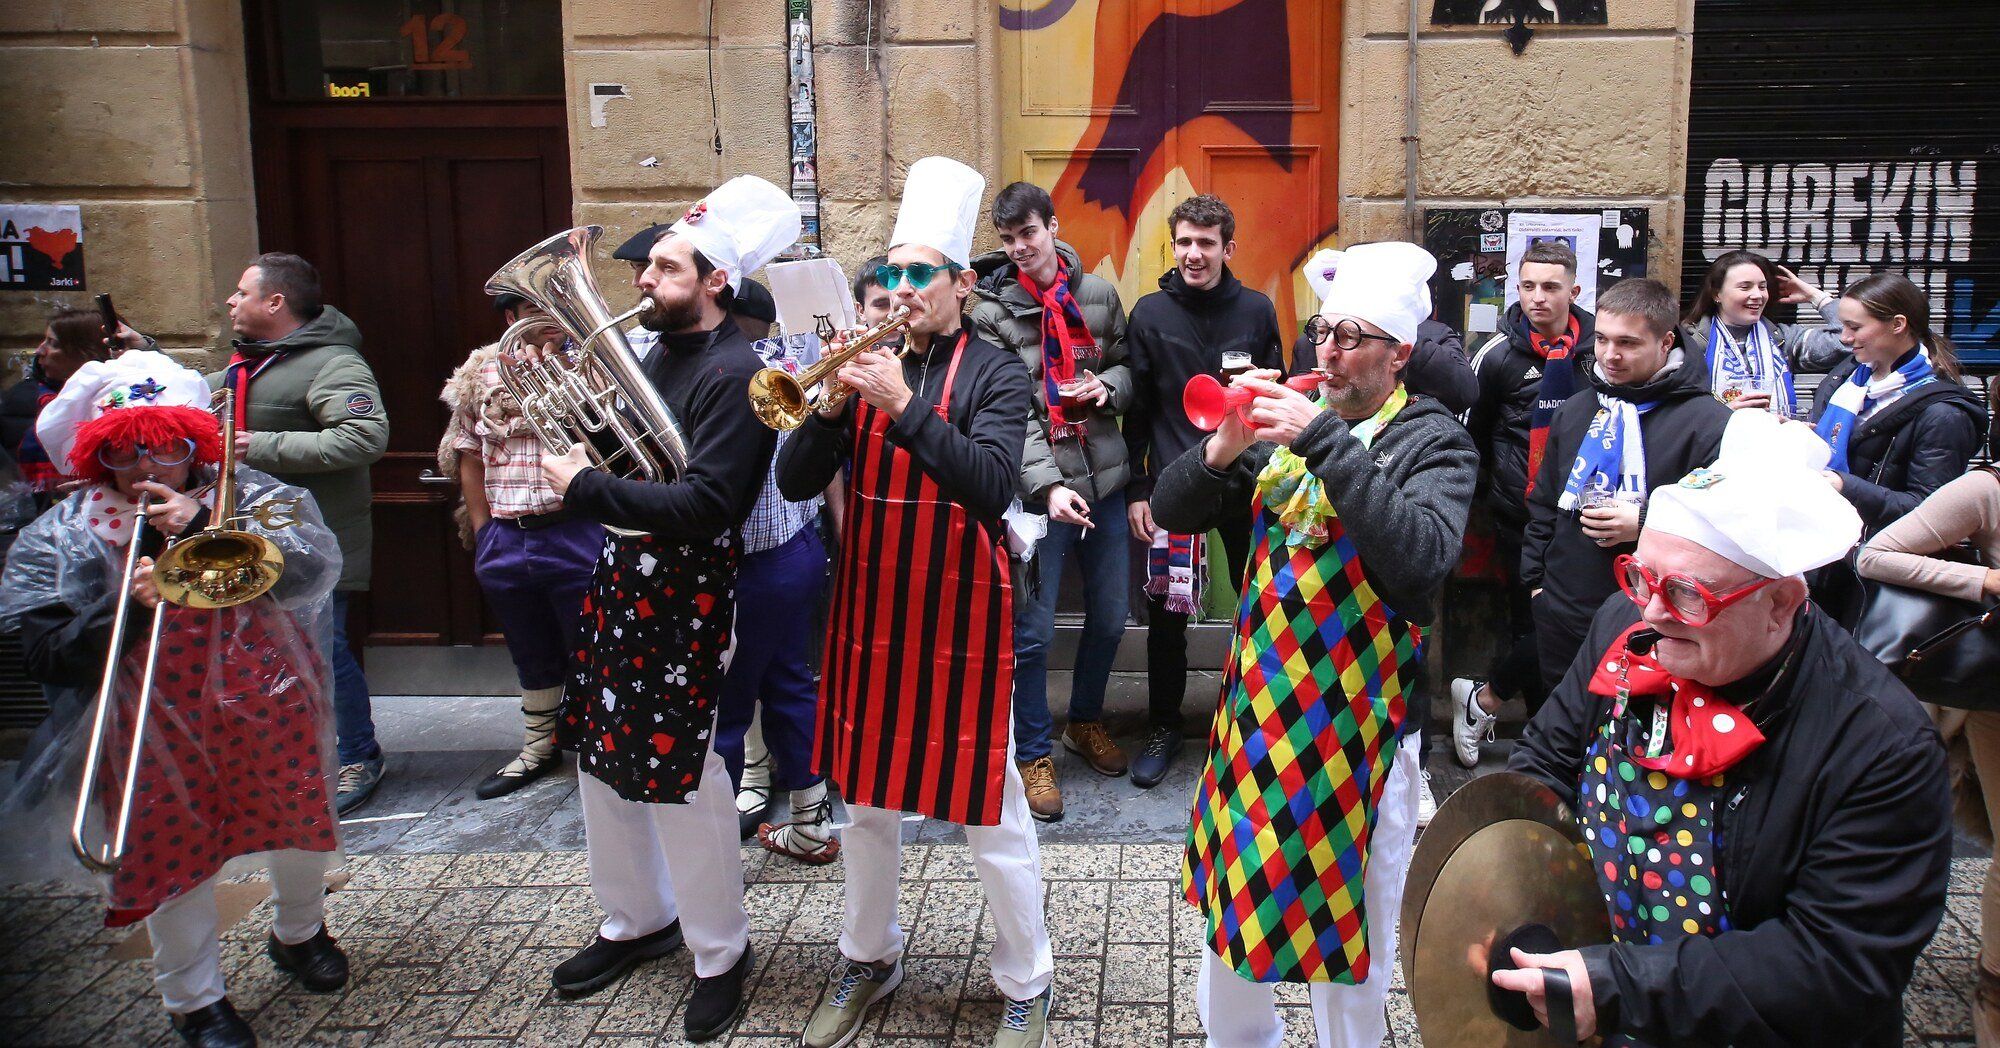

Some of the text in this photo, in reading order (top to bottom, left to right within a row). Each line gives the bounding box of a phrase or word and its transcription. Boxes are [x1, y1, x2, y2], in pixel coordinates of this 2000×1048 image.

[401, 13, 472, 63] 12
[1702, 158, 1977, 262] GUREKIN
[50, 278, 73, 286] Jarki
[1523, 372, 1543, 380] adidas
[1539, 399, 1567, 409] DIADO
